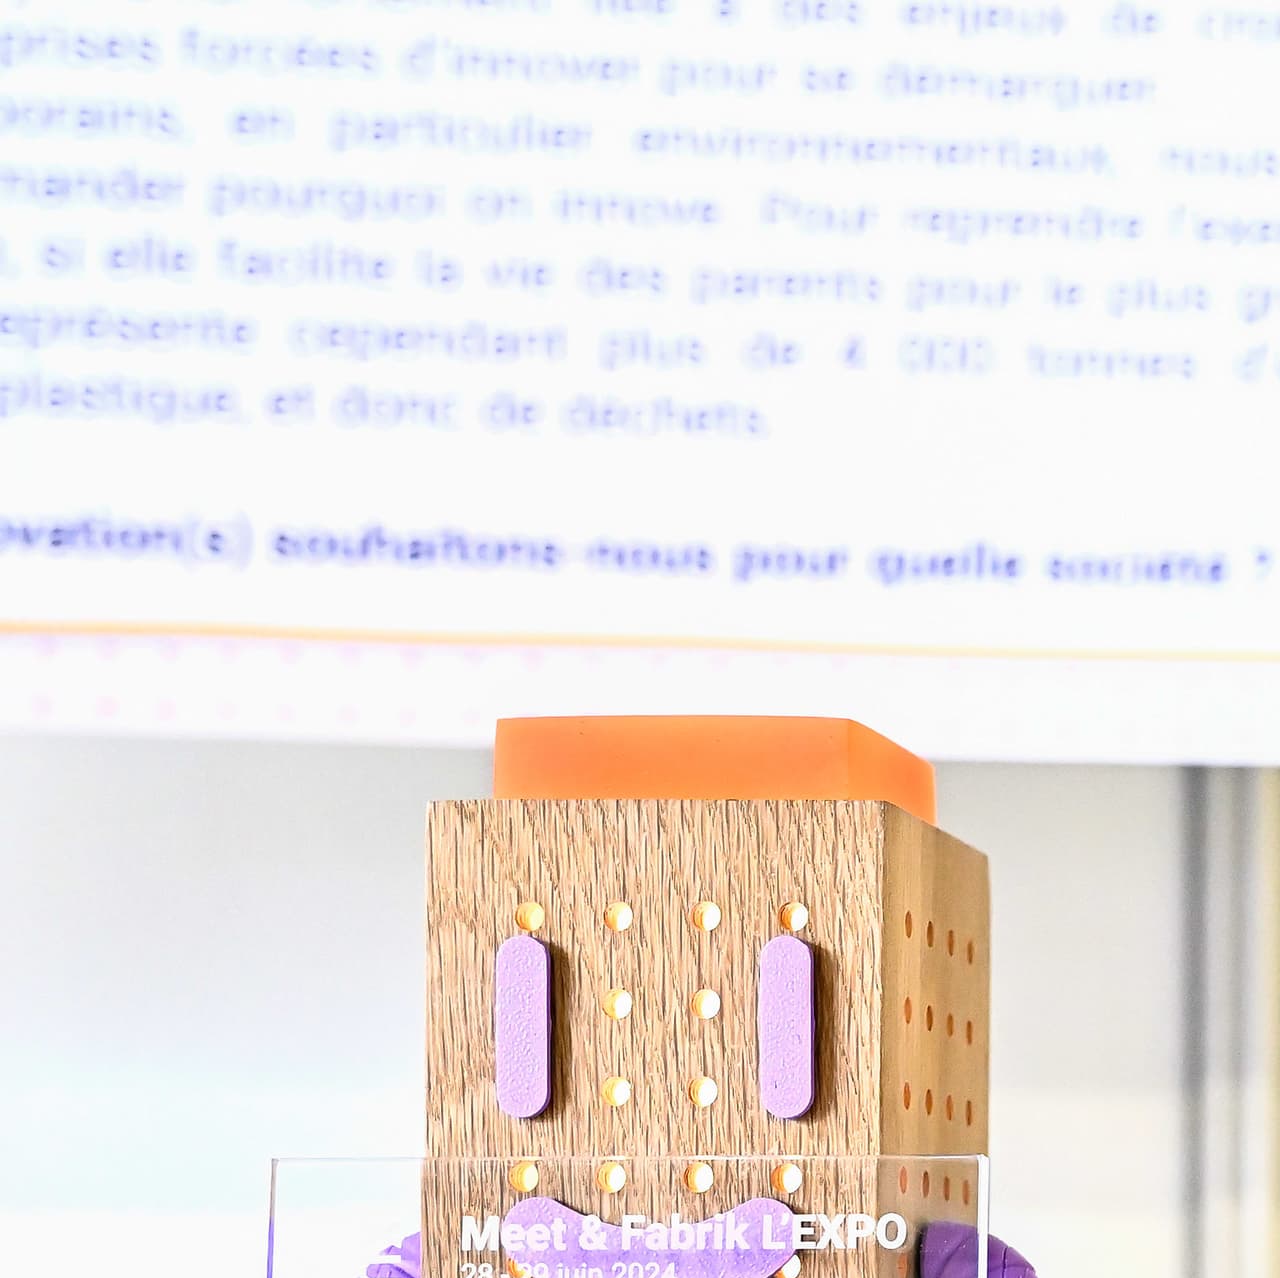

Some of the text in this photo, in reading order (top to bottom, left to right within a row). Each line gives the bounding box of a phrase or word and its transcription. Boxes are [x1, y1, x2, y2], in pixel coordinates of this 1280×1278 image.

[461, 1212, 908, 1251] Meet & Fabrik L'EXPO
